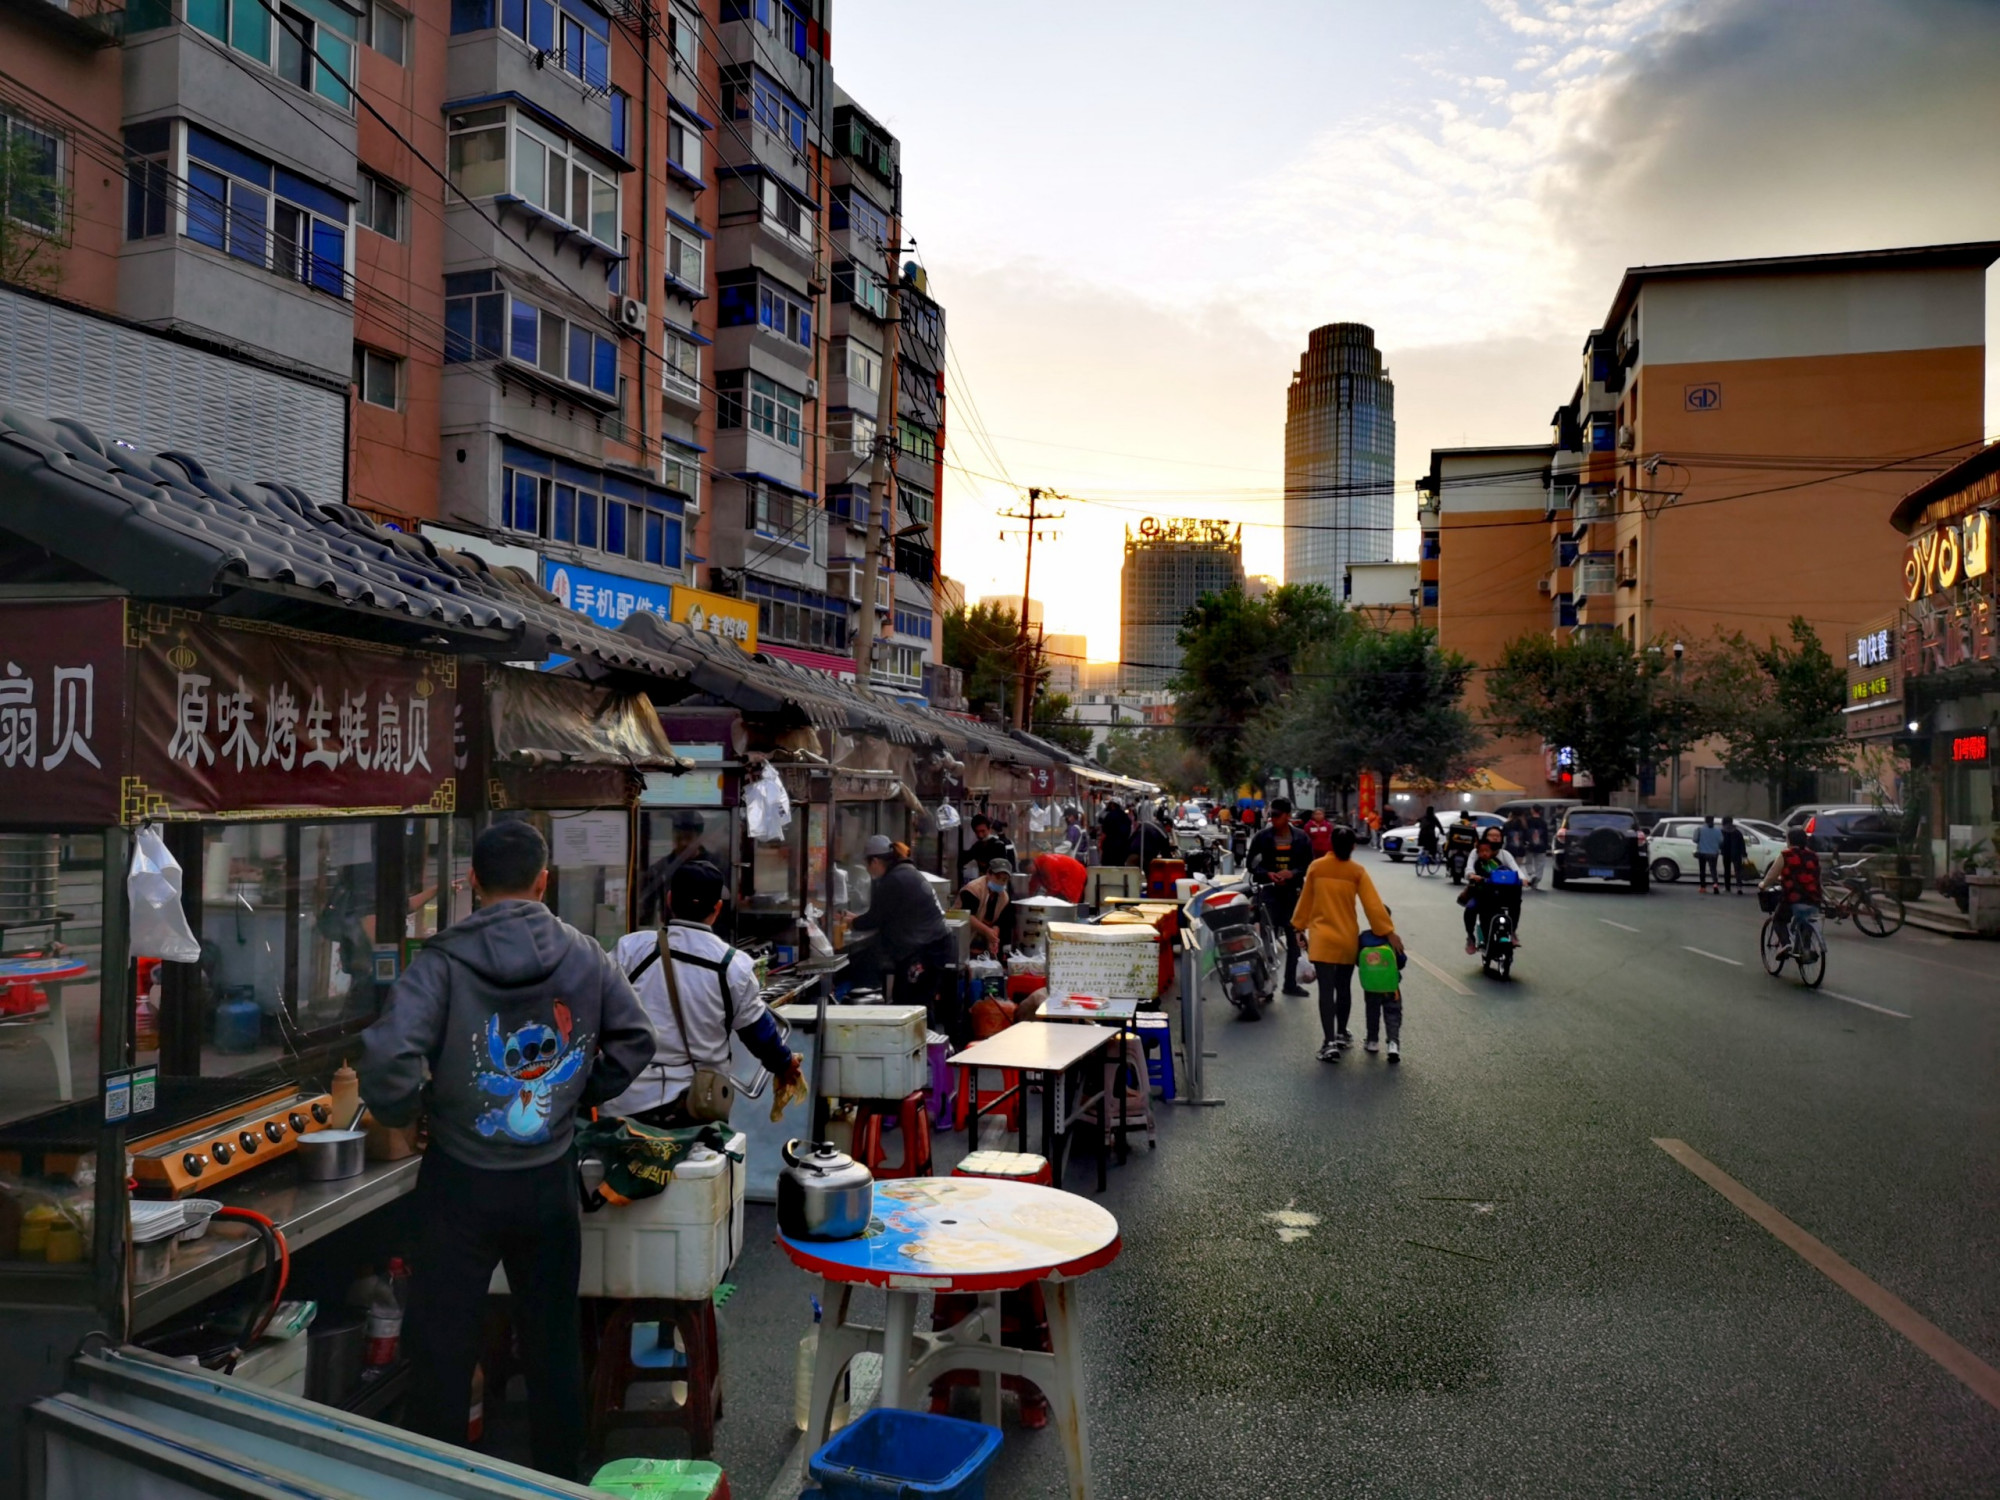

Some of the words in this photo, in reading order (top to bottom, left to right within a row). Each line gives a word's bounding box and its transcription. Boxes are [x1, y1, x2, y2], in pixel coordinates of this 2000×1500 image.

[575, 583, 654, 621] 手机配件
[1848, 629, 1889, 668] 一和快餐
[0, 661, 102, 772] 扇贝
[167, 671, 434, 775] 原味烤生蚝扇贝
